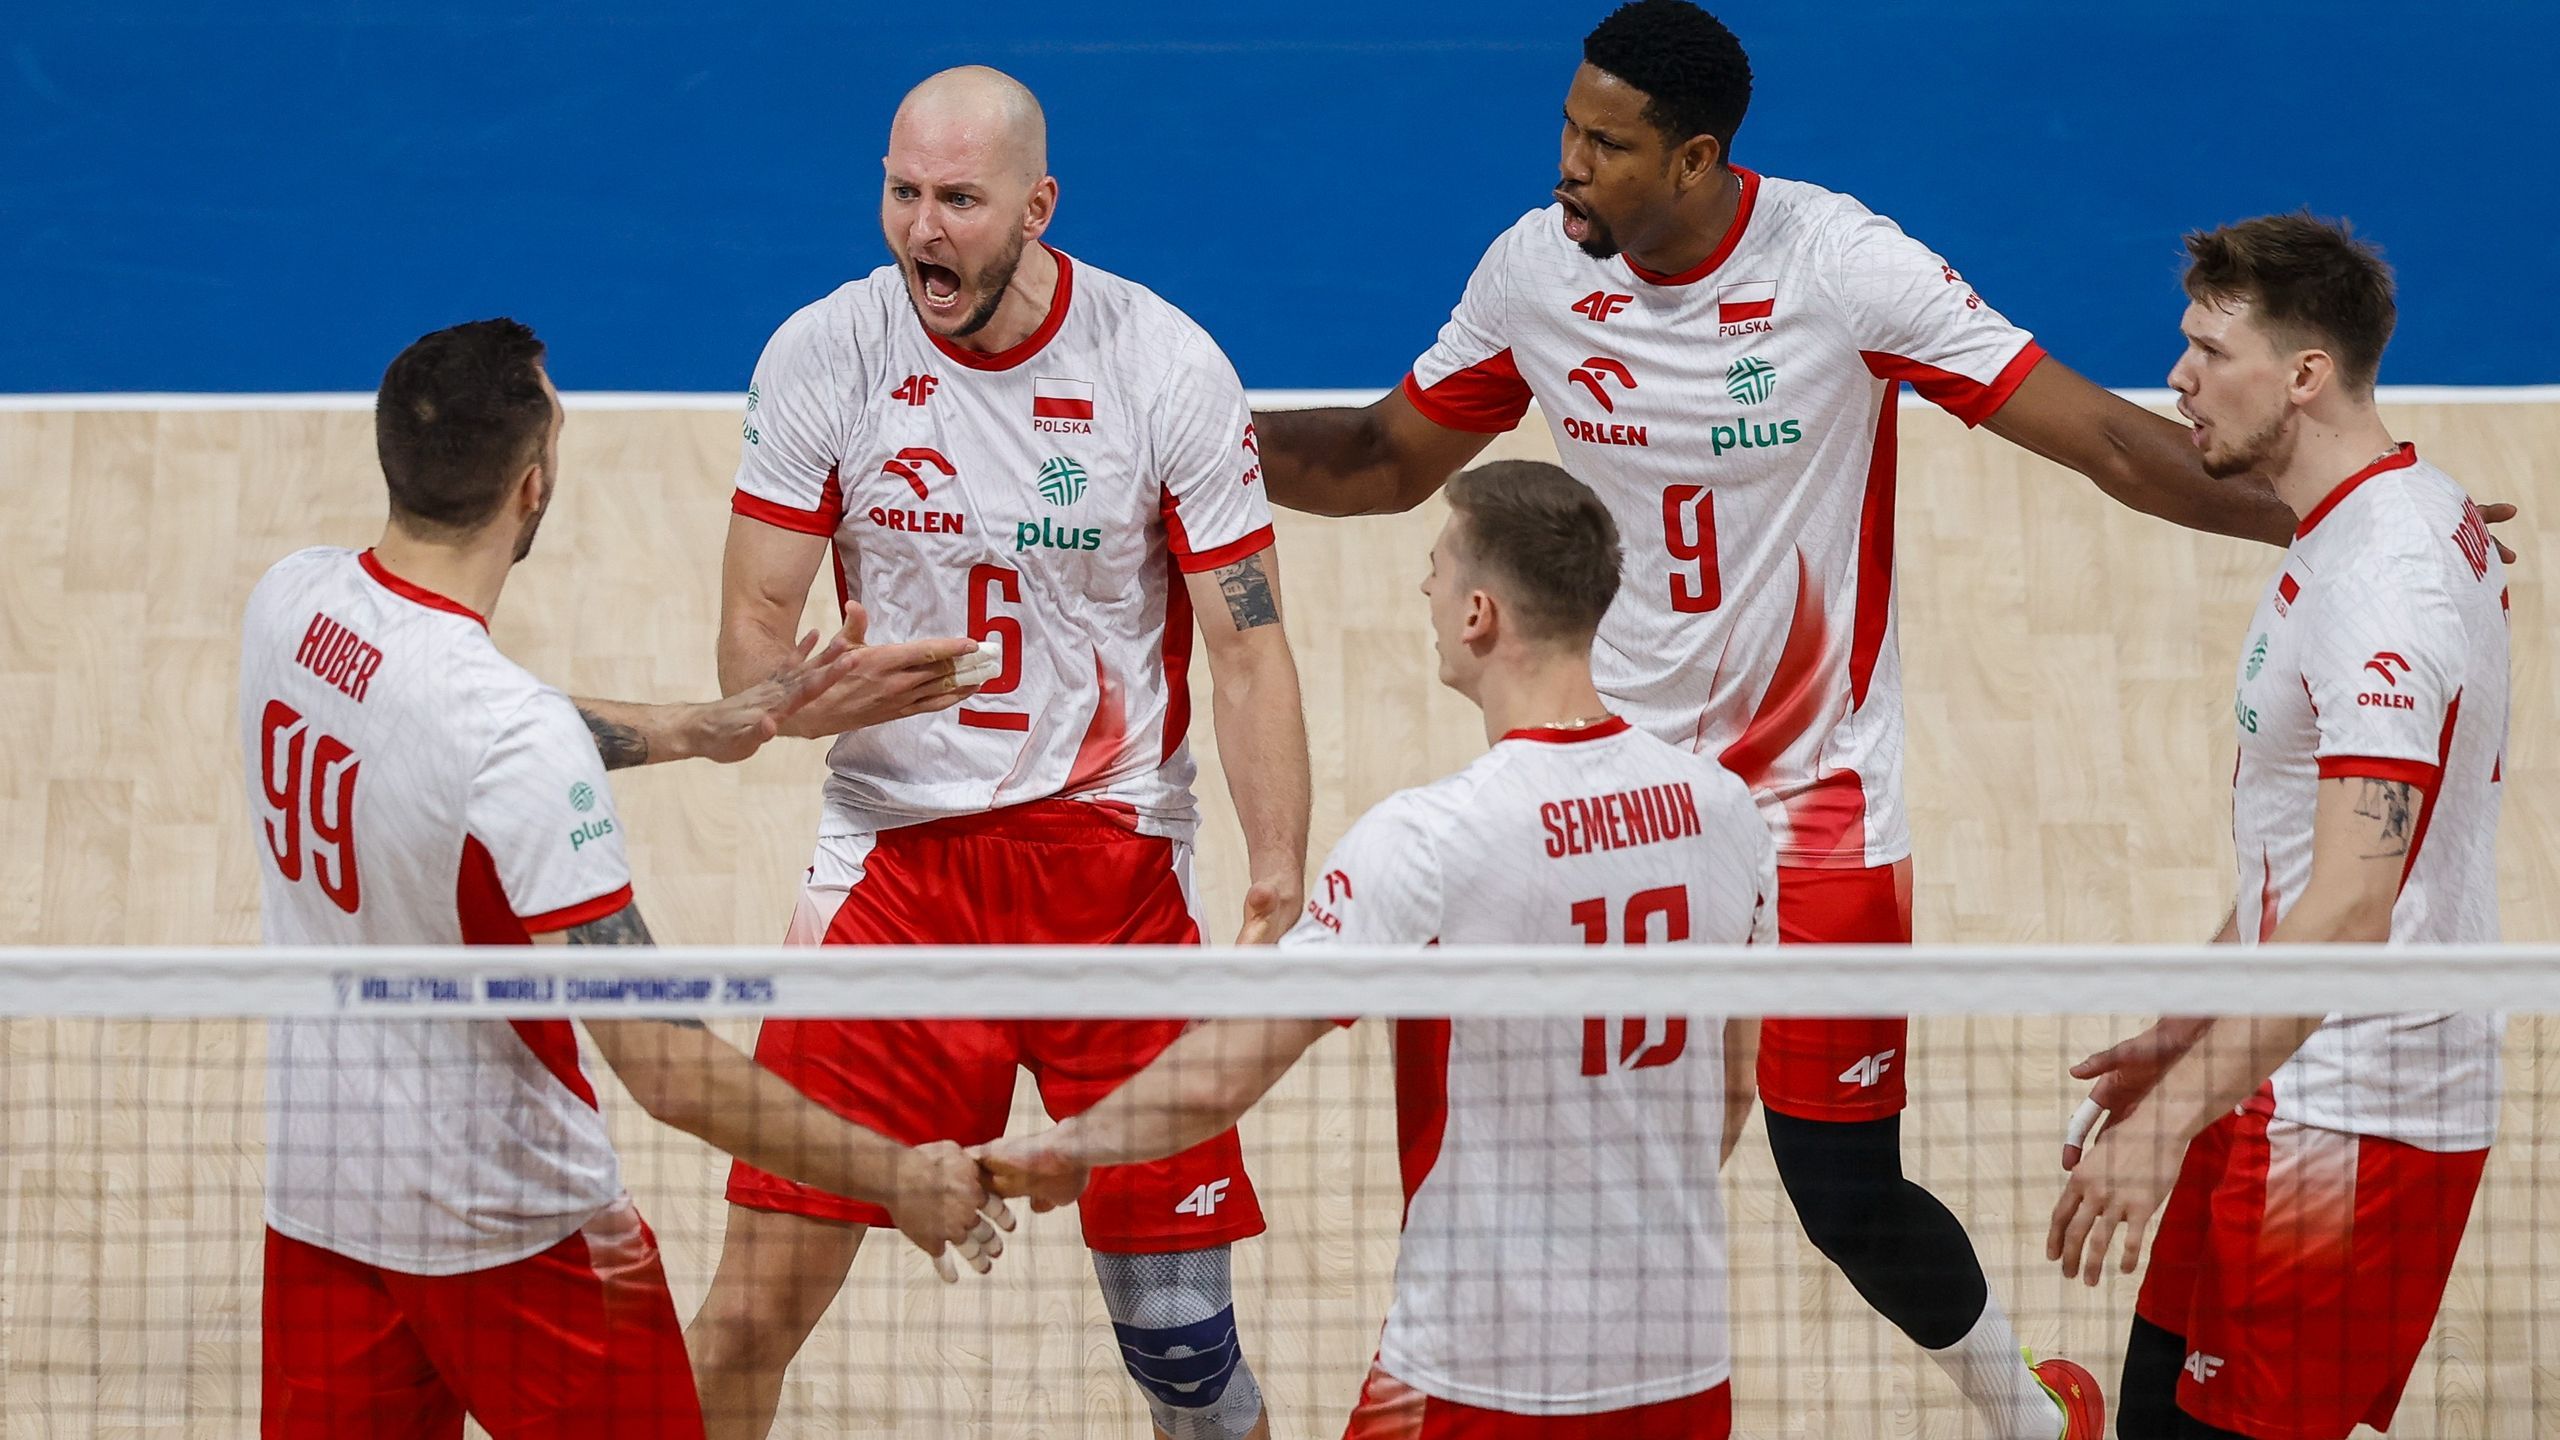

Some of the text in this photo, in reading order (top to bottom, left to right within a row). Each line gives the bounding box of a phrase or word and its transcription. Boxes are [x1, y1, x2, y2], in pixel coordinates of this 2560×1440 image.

[1571, 290, 1634, 322] 4F
[1718, 320, 1774, 338] POLSKA
[891, 374, 939, 407] 4F
[1033, 419, 1092, 435] POLSKA
[1563, 417, 1648, 447] ORLEN
[1711, 418, 1803, 456] plus
[868, 505, 964, 535] ORLEN
[1015, 517, 1102, 552] plus
[1662, 483, 1723, 614] 9
[966, 563, 1023, 695] 6
[295, 611, 384, 703] HUBER
[2357, 691, 2416, 711] ORLEN
[261, 698, 362, 914] 99
[1540, 781, 1703, 859] SEMENIUK
[570, 814, 614, 851] plus
[1838, 1048, 1896, 1088] 4F
[1175, 1177, 1231, 1217] 4F
[2184, 1350, 2225, 1384] 4F
